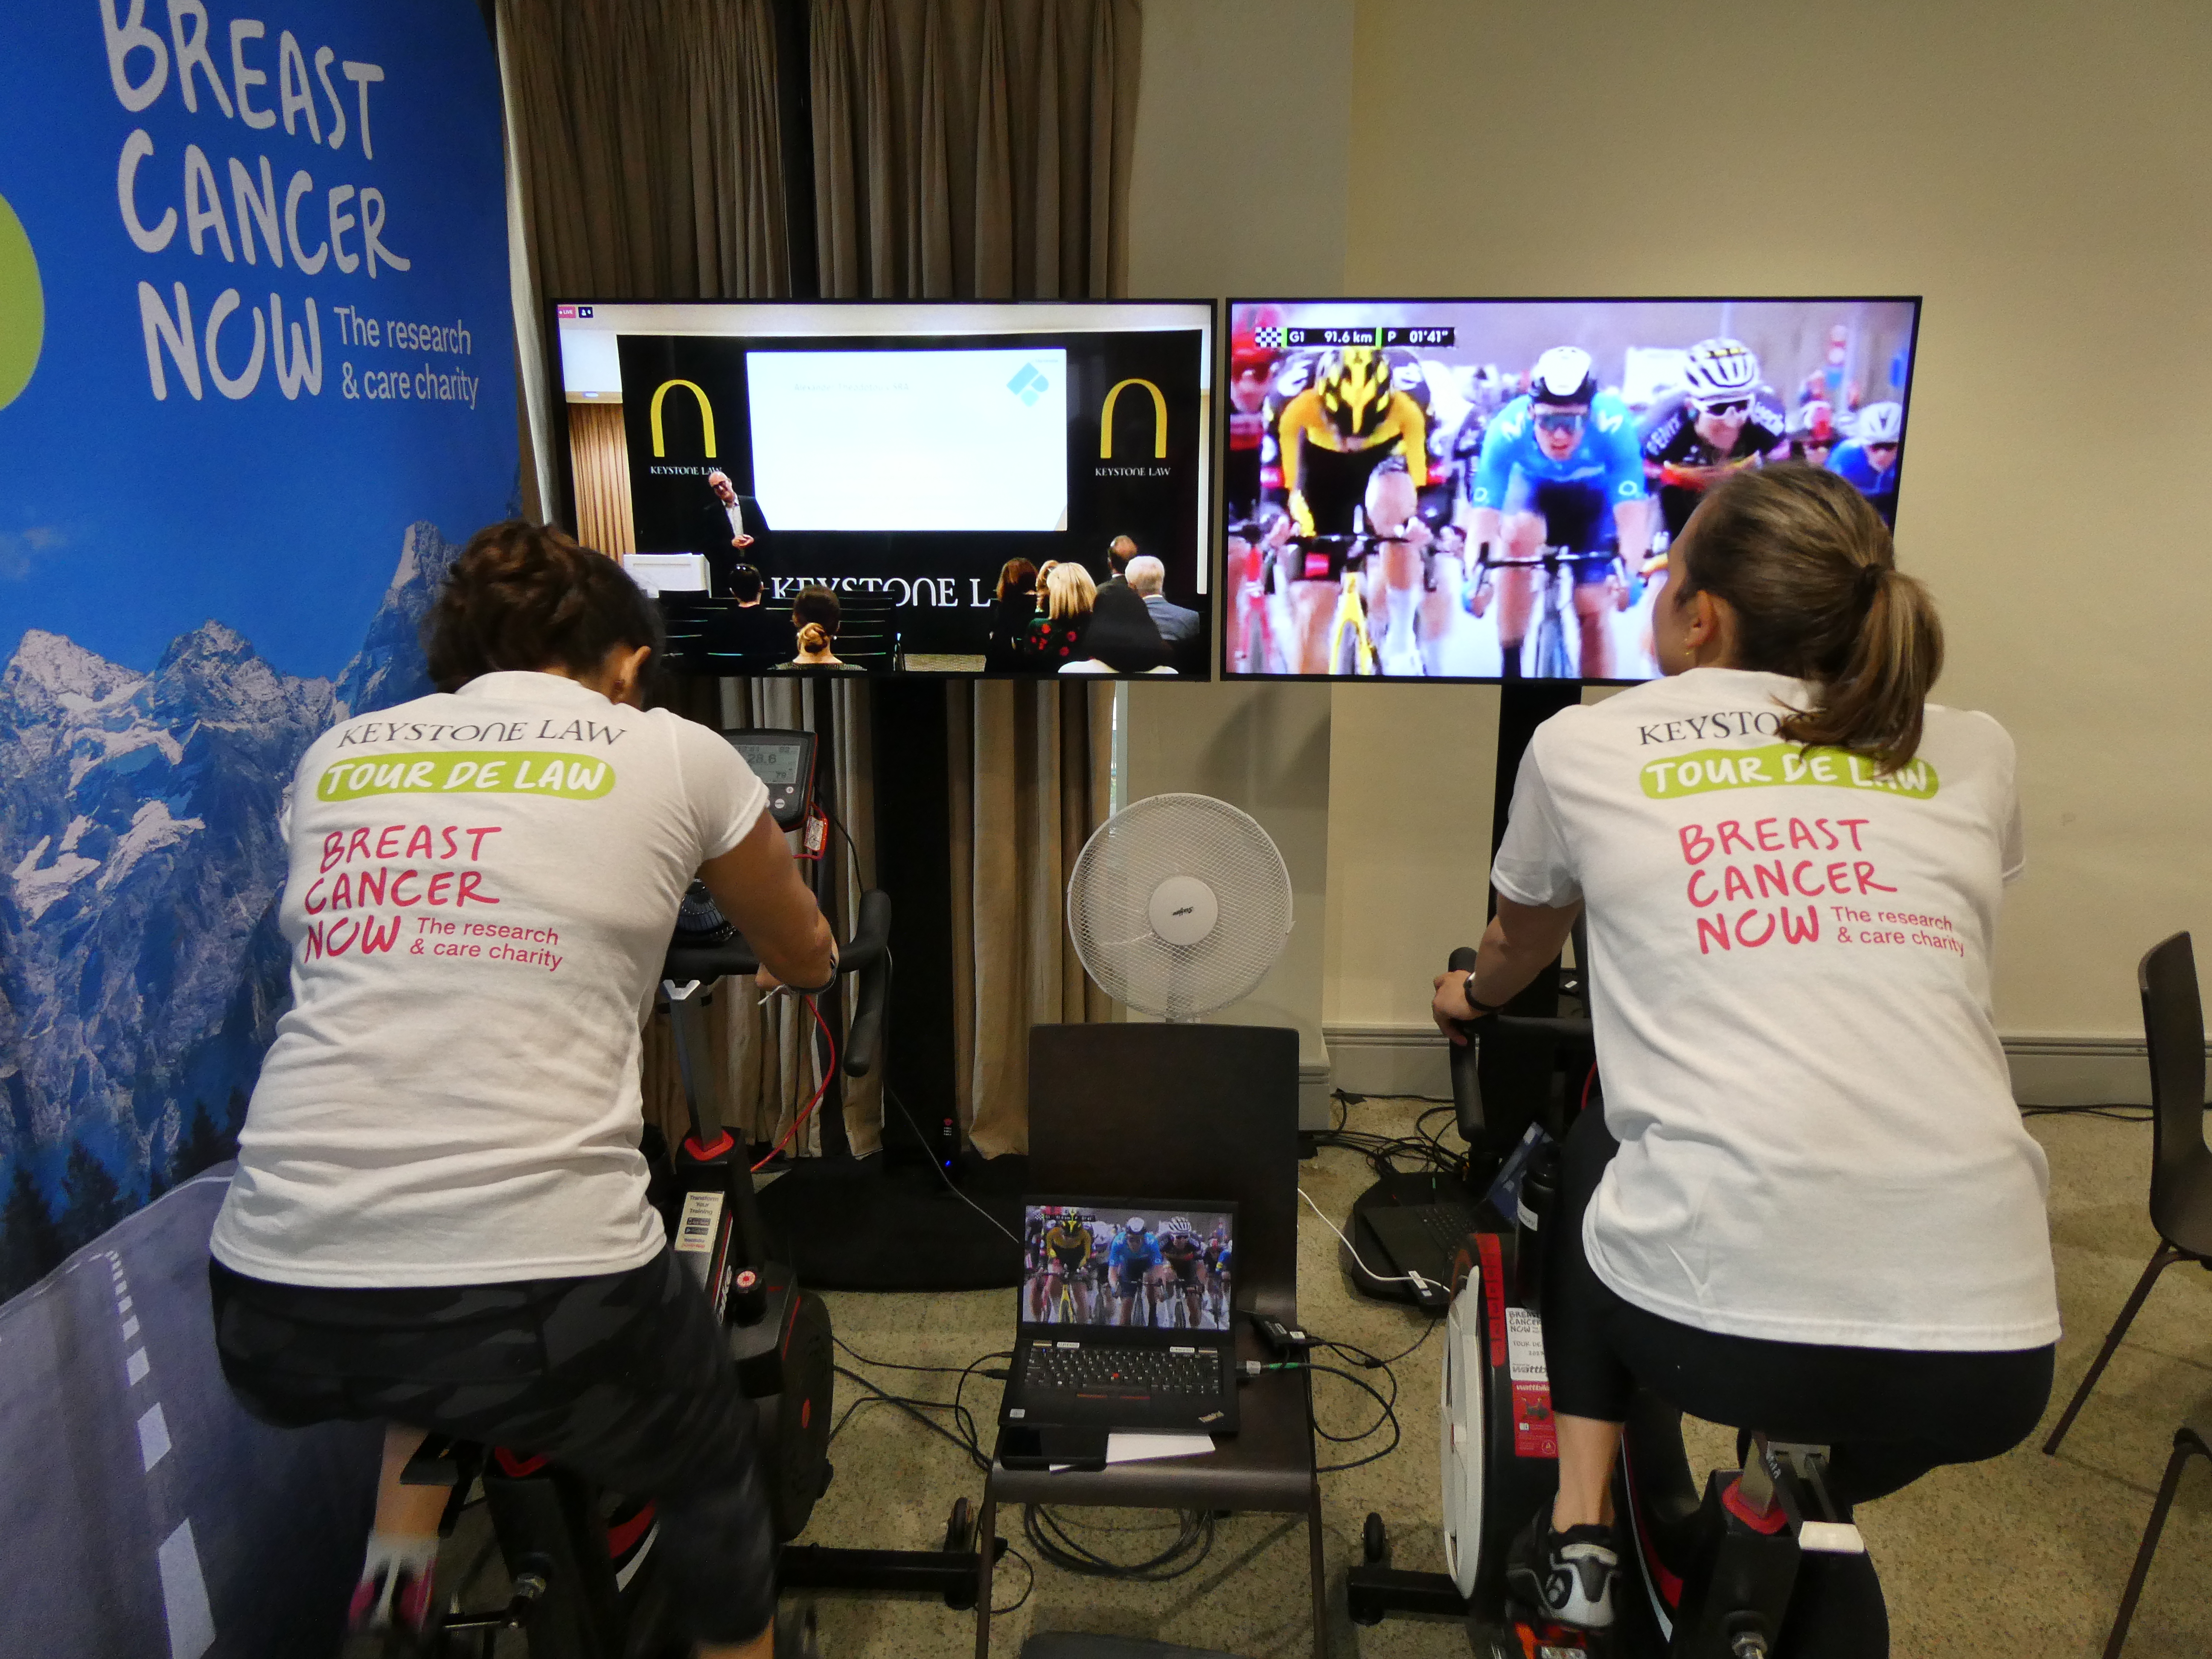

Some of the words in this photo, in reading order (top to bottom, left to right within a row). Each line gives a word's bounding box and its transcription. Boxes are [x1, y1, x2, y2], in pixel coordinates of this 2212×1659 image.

[100, 0, 384, 160] BREAST
[117, 129, 410, 278] CANCER
[137, 281, 322, 401] NOW
[334, 305, 380, 346] The
[387, 318, 471, 355] research
[1289, 332, 1304, 343] G1
[1324, 331, 1350, 343] 91.6
[1353, 331, 1372, 343] km
[1388, 332, 1397, 343] P
[341, 362, 360, 399] &
[364, 370, 410, 400] care
[415, 363, 478, 410] charity
[651, 466, 699, 475] KEYSTONE
[1095, 467, 1146, 476] KEYSTONE
[1149, 468, 1171, 476] LAW
[337, 722, 527, 748] KEYSTONE
[535, 719, 627, 746] LAW
[1639, 711, 1781, 746] KEYSTO
[327, 761, 433, 795] TOUR
[442, 760, 505, 790] DE
[513, 760, 606, 791] LAW
[1646, 757, 1771, 793] TOUR
[1782, 753, 1838, 782] DE
[319, 824, 502, 874] BREAST
[1679, 817, 1870, 866] BREAST
[304, 866, 501, 915] CANCER
[1687, 859, 1898, 908] CANCER
[417, 917, 456, 936] The
[463, 921, 559, 945] research
[1697, 904, 1819, 955] NOW
[1830, 905, 1871, 923] The
[1878, 909, 1953, 931] research
[304, 914, 402, 963] NOW
[410, 939, 425, 955] &
[433, 942, 482, 958] care
[489, 942, 563, 972] charity
[1837, 927, 1853, 944] &
[1860, 930, 1905, 945] care
[1912, 930, 1965, 957] charity
[1512, 1365, 1546, 1373] wattb
